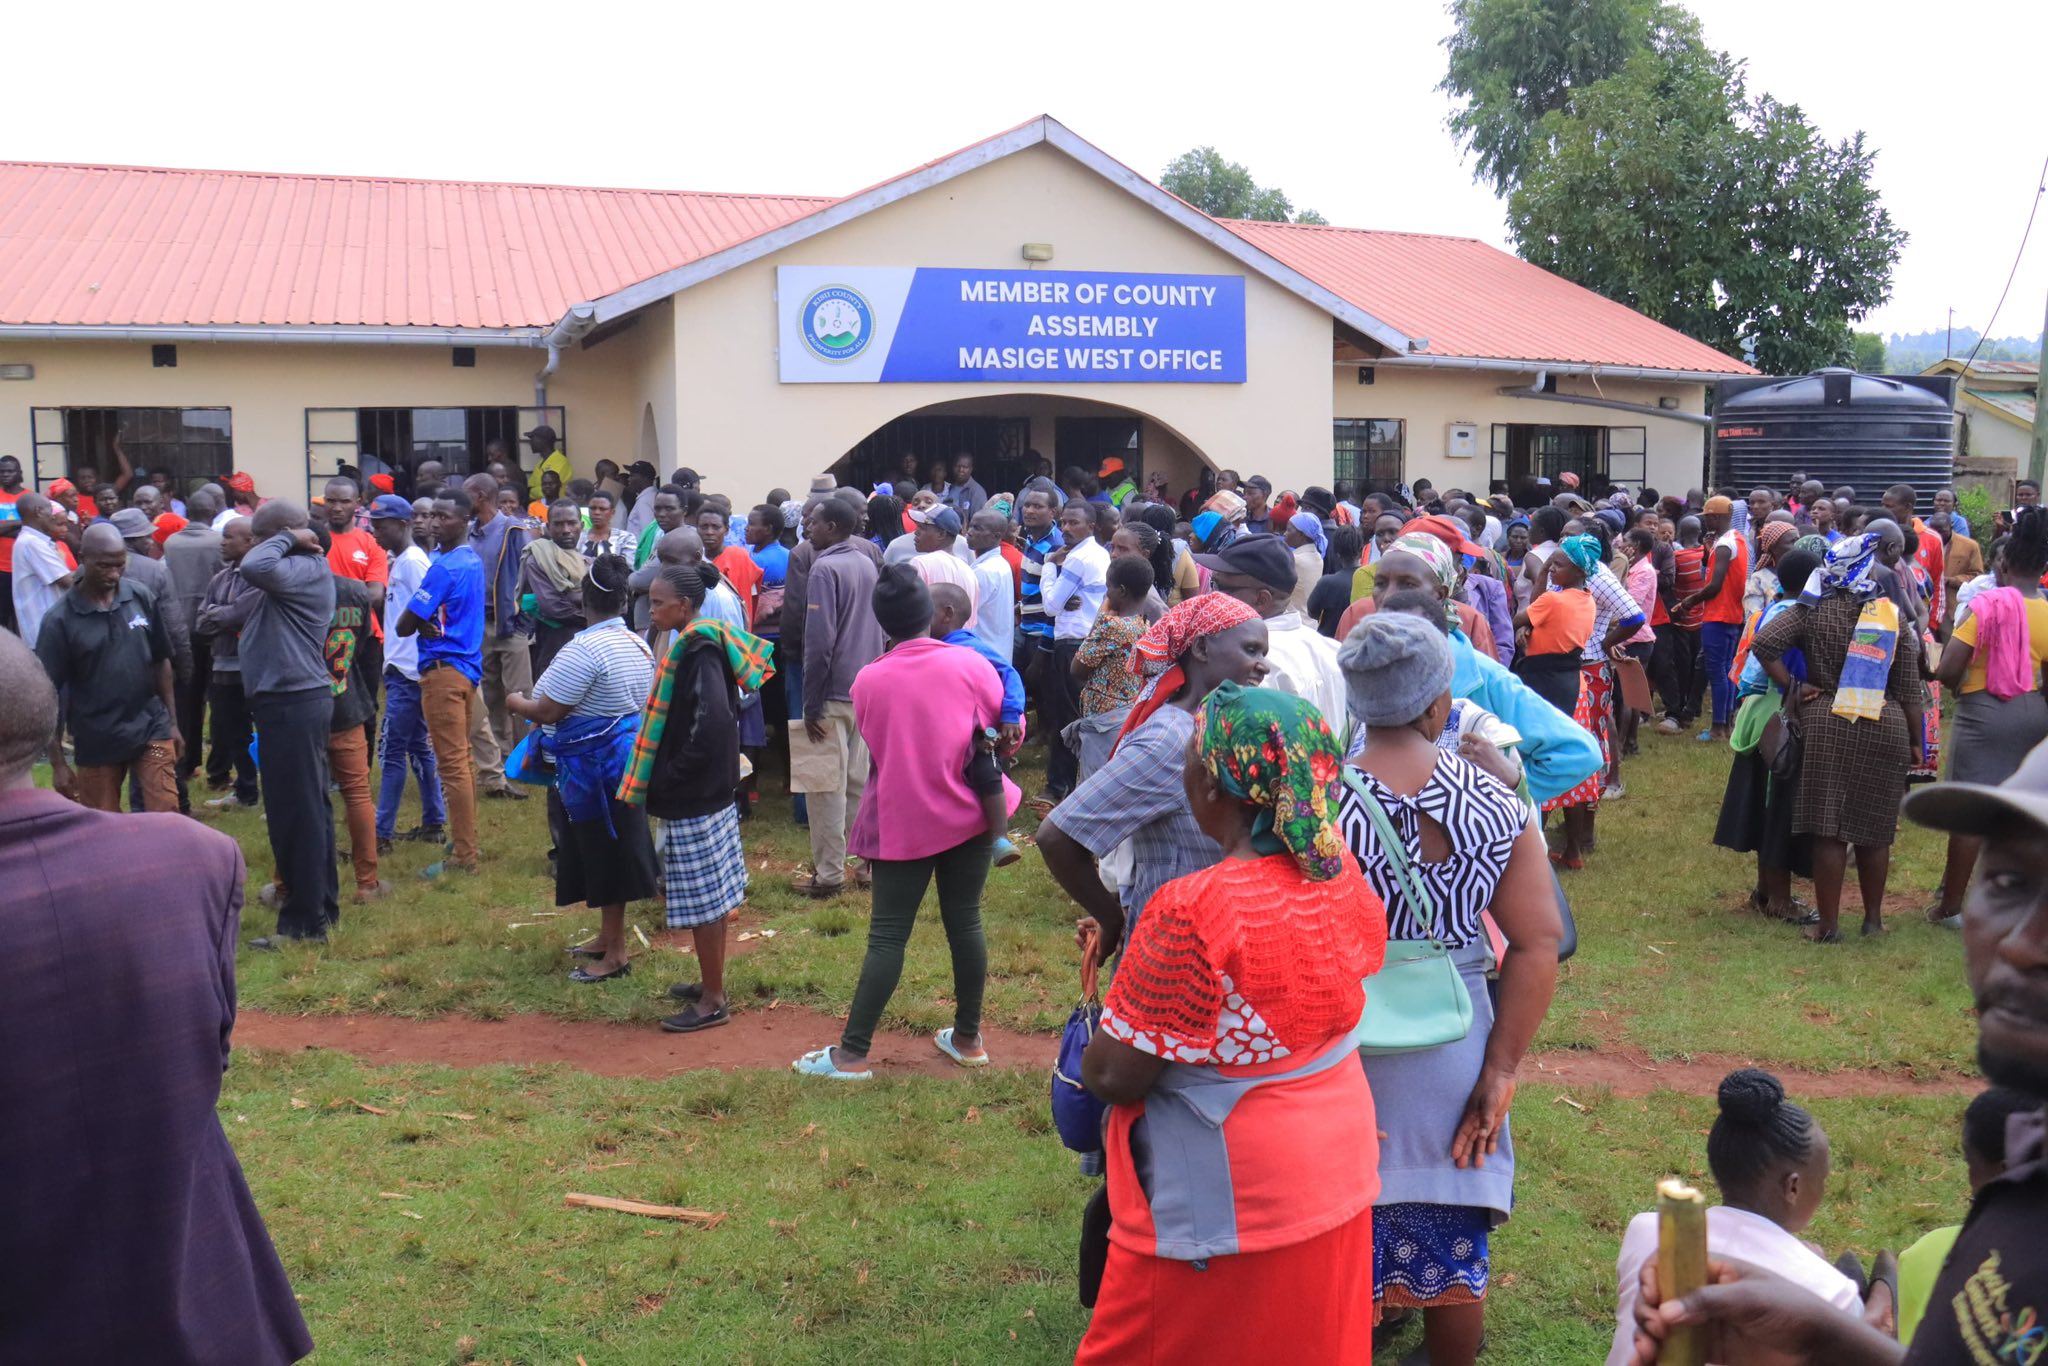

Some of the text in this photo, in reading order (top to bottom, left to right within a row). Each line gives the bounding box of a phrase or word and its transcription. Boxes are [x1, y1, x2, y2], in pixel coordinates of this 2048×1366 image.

[831, 290, 863, 309] COUNTY
[961, 280, 1216, 306] MEMBER OF COUNTY
[1028, 315, 1158, 337] ASSEMBLY
[842, 346, 856, 355] FOR
[855, 337, 866, 349] ALL
[960, 347, 1222, 370] MASIGE WEST OFFICE
